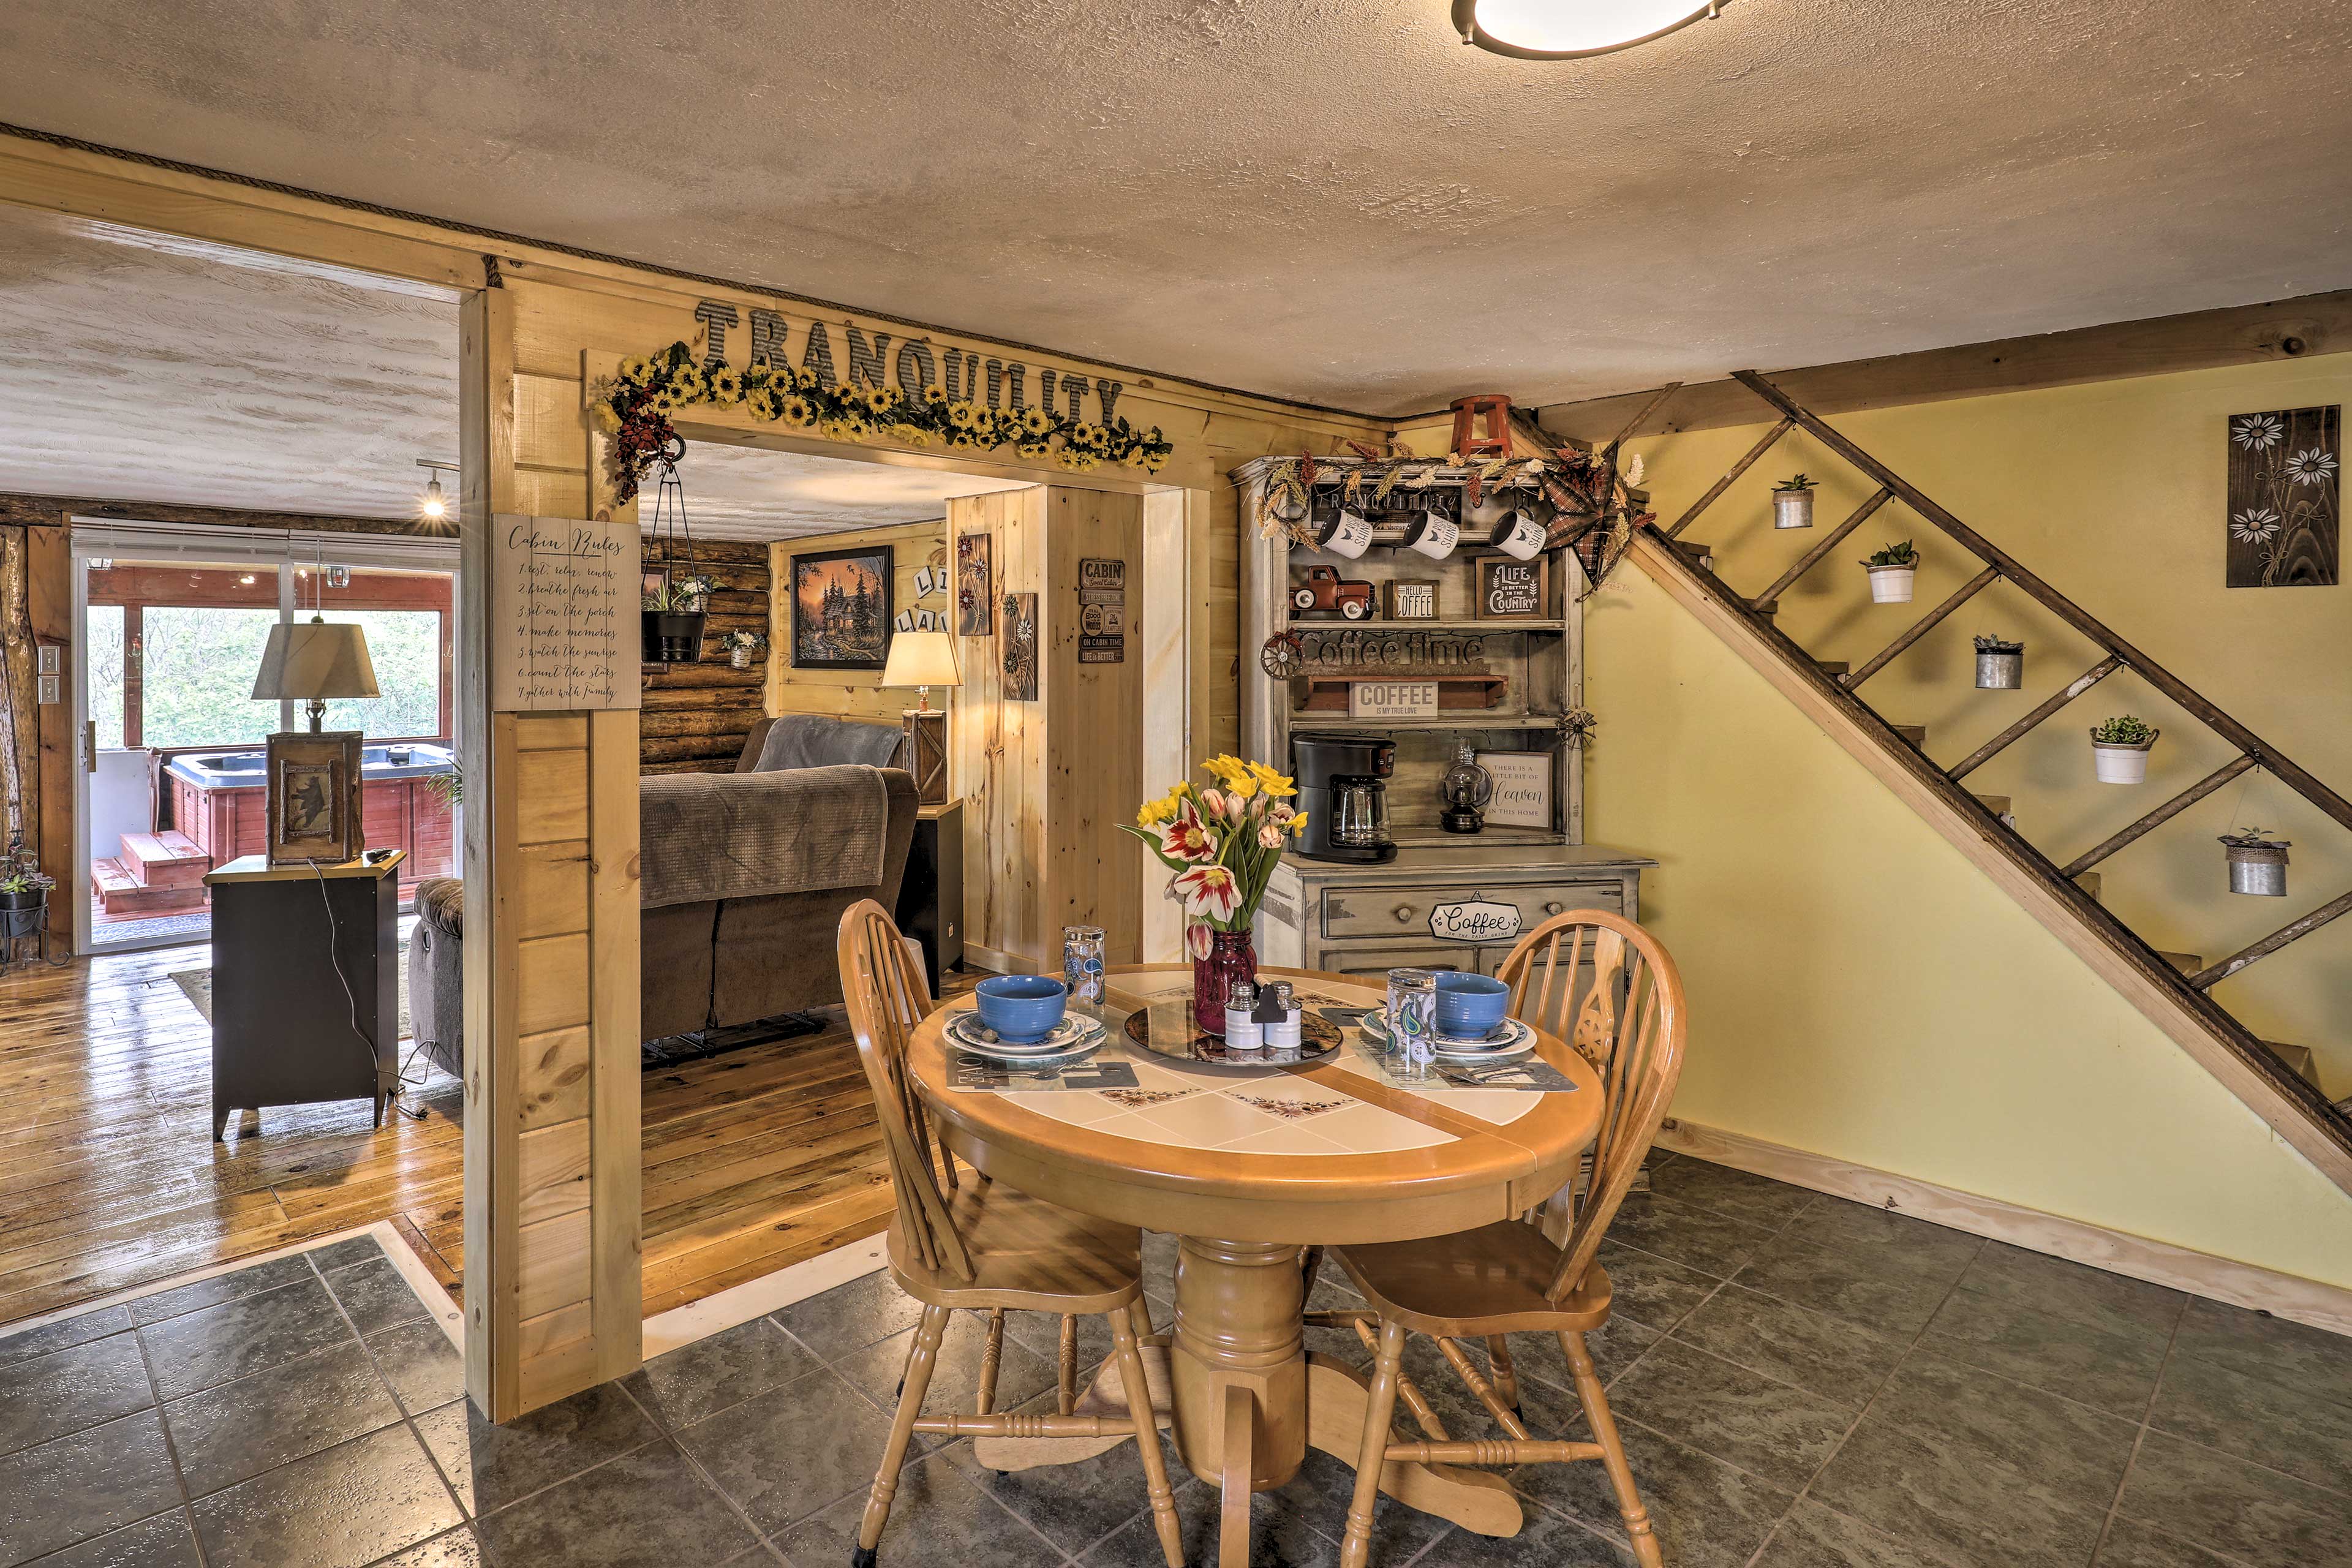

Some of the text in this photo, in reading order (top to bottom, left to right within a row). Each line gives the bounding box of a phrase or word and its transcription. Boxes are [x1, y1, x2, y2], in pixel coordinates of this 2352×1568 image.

[509, 525, 625, 559] Cabin Rules
[1354, 522, 1371, 547] SHINE
[1441, 523, 1457, 548] SHINE
[1528, 524, 1544, 549] SHINE
[587, 568, 617, 579] renew
[1086, 563, 1121, 578] CABIN
[1496, 565, 1530, 585] LIFE
[572, 584, 600, 601] fresh
[1406, 586, 1422, 595] HELLO
[1490, 590, 1537, 613] COUNTRY
[564, 602, 583, 617] the
[585, 606, 616, 625] porch
[566, 629, 617, 640] memories
[564, 644, 581, 657] the
[584, 648, 617, 658] sunrise
[1300, 630, 1486, 665] Coffee time
[565, 665, 586, 677] the
[589, 665, 616, 679] stars
[559, 684, 581, 698] with
[582, 682, 617, 703] family
[1360, 685, 1433, 705] COFFEE
[1443, 907, 1510, 934] Coffee
